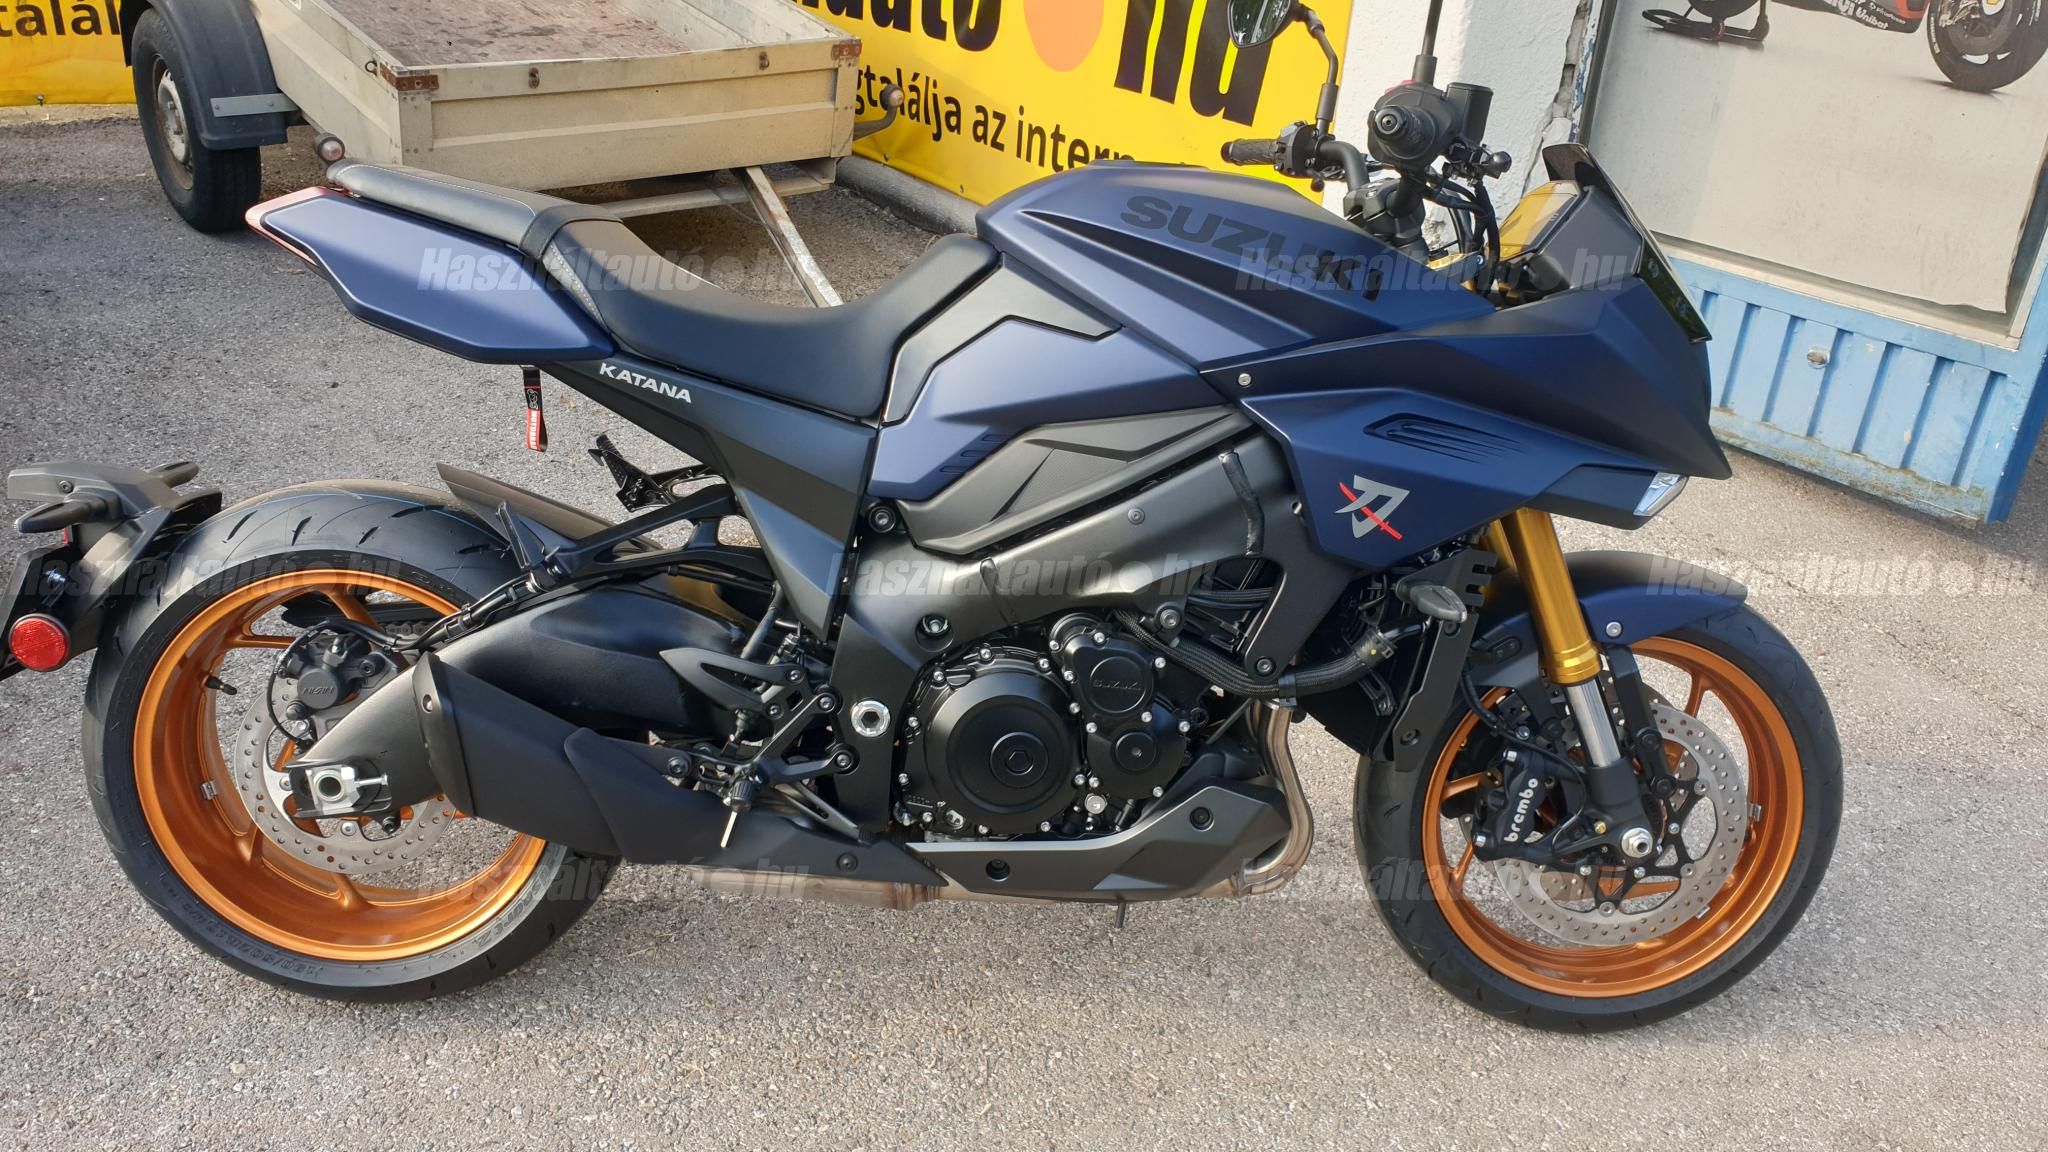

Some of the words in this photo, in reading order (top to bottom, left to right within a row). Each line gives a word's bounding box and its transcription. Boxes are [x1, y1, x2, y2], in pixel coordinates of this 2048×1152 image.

[972, 104, 1007, 152] az
[1016, 105, 1136, 173] inter
[1119, 194, 1384, 302] SUZUKI
[600, 362, 692, 404] KATANA
[1503, 777, 1539, 843] brembo
